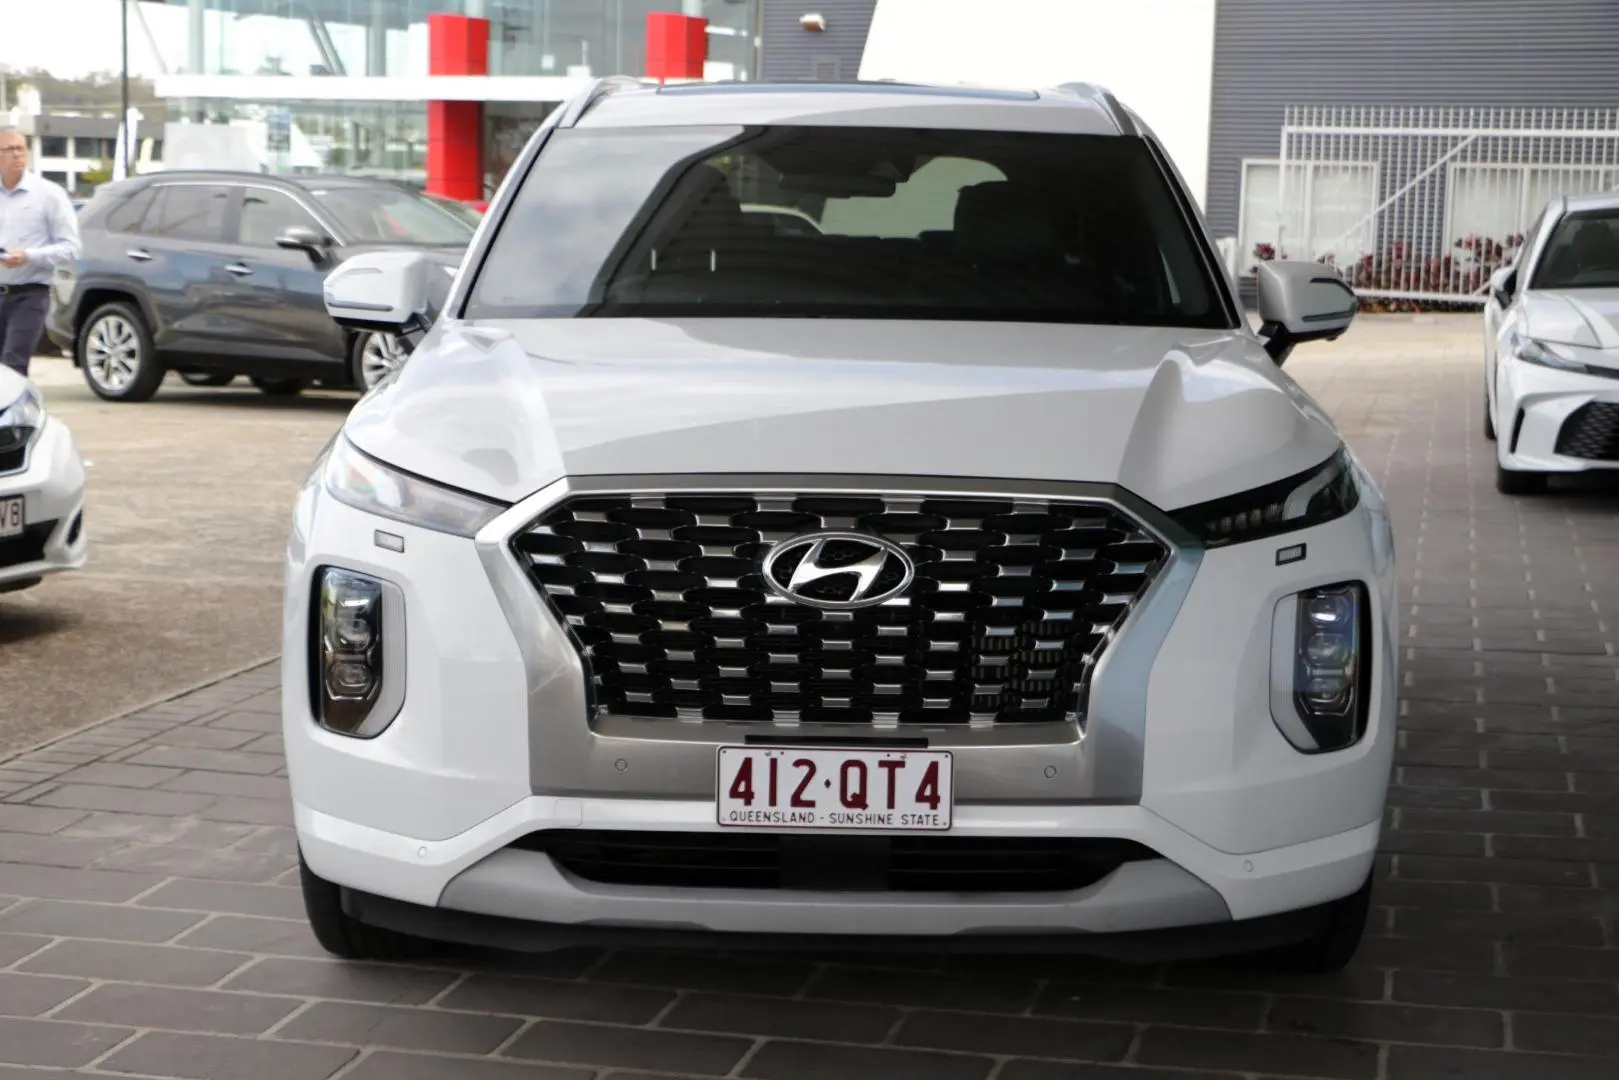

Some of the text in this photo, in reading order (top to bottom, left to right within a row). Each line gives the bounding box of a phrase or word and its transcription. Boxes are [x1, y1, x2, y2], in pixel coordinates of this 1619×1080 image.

[729, 810, 815, 823] QUEENSLAND
[829, 812, 893, 825] SUNSHINE
[900, 814, 940, 826] STATE
